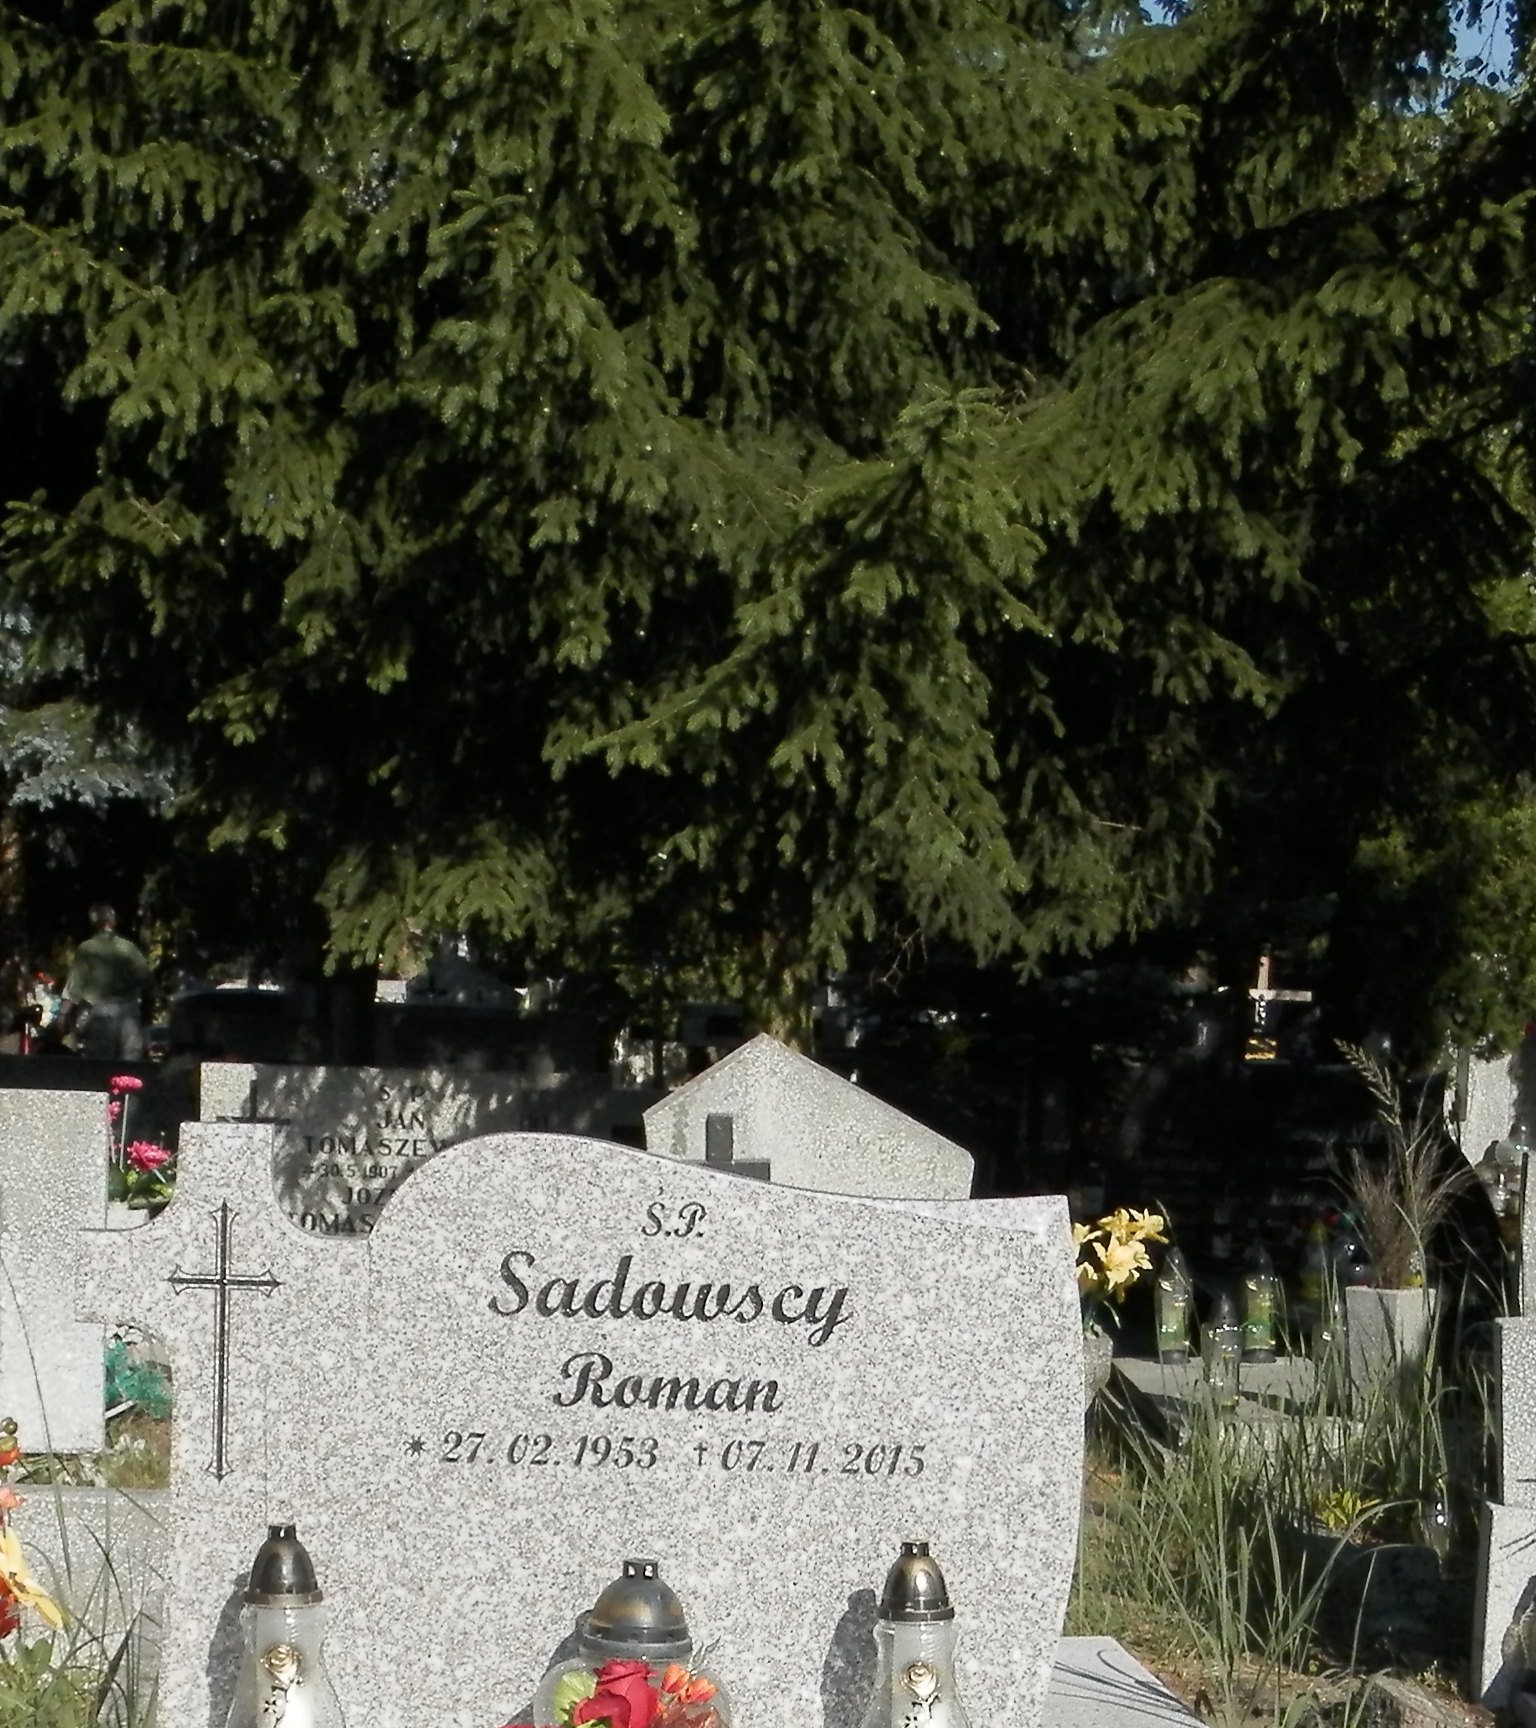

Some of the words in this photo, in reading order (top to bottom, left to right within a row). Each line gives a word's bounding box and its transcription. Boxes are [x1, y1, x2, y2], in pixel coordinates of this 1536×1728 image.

[377, 1110, 426, 1130] JAN
[487, 1250, 854, 1347] Sadowscy
[552, 1352, 781, 1413] Roman
